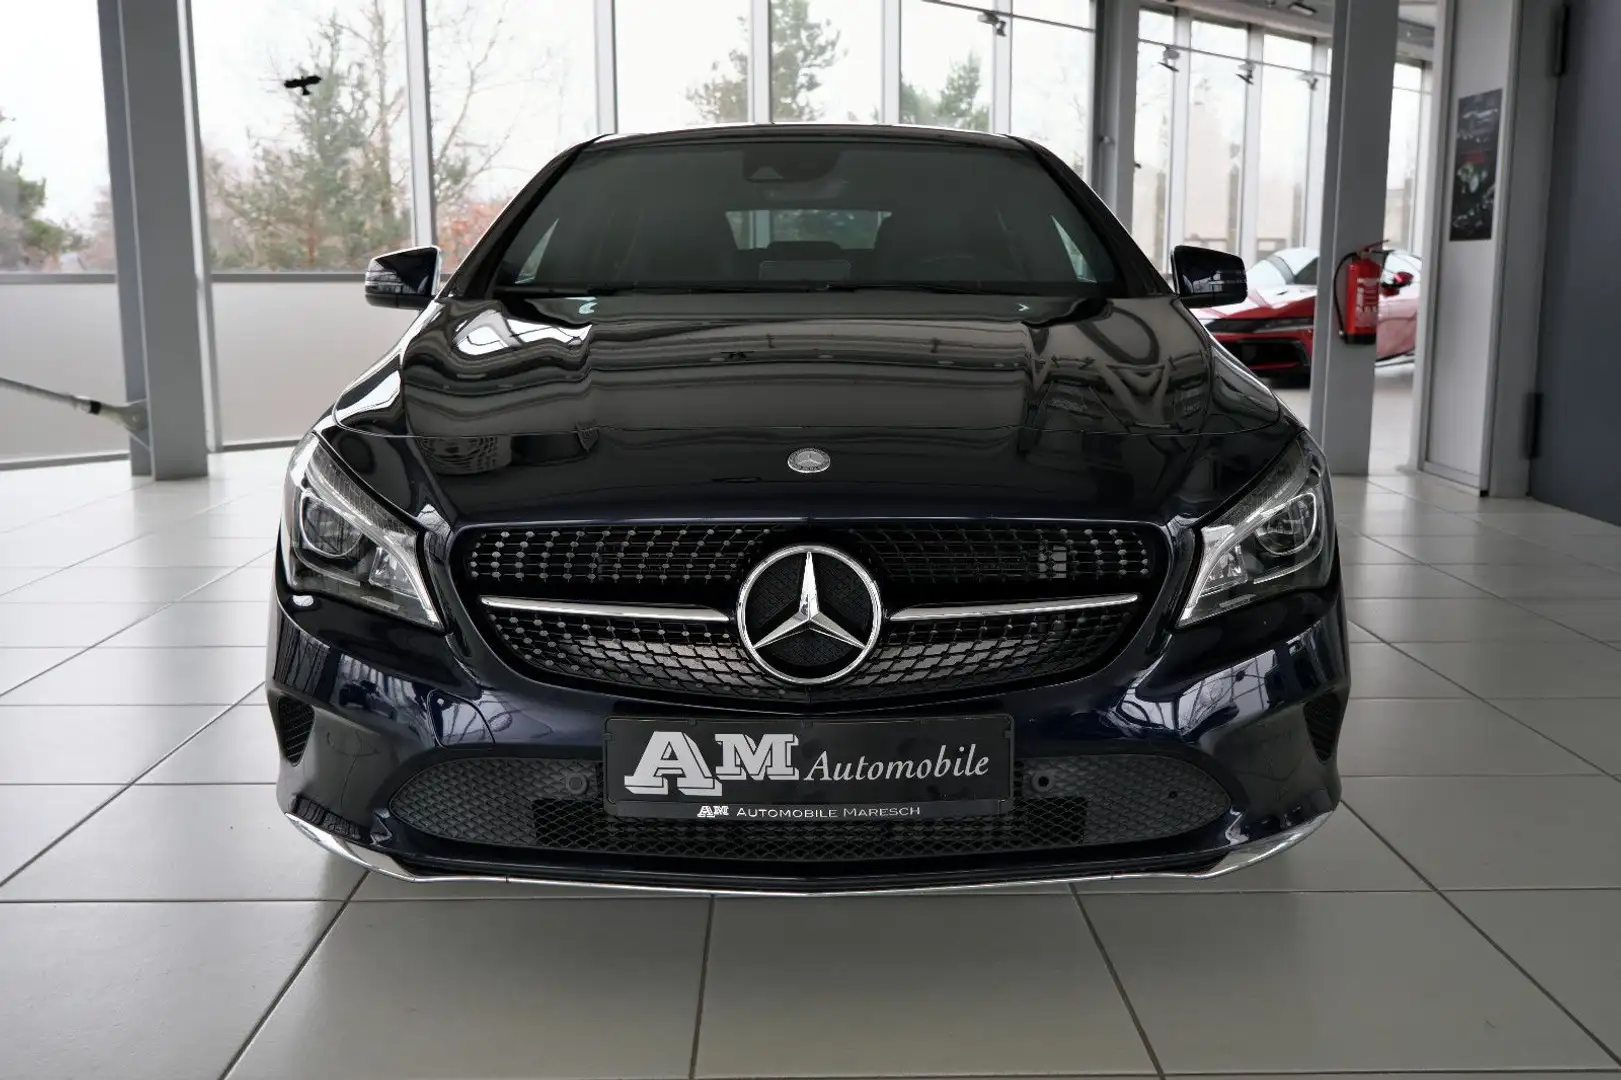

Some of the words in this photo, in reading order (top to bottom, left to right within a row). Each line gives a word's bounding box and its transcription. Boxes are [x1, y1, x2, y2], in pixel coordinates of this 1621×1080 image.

[624, 730, 800, 796] AM
[803, 743, 990, 781] Automobile
[697, 805, 730, 818] AM
[736, 807, 839, 819] AUTOMOBILE
[843, 806, 921, 818] MARESCH
